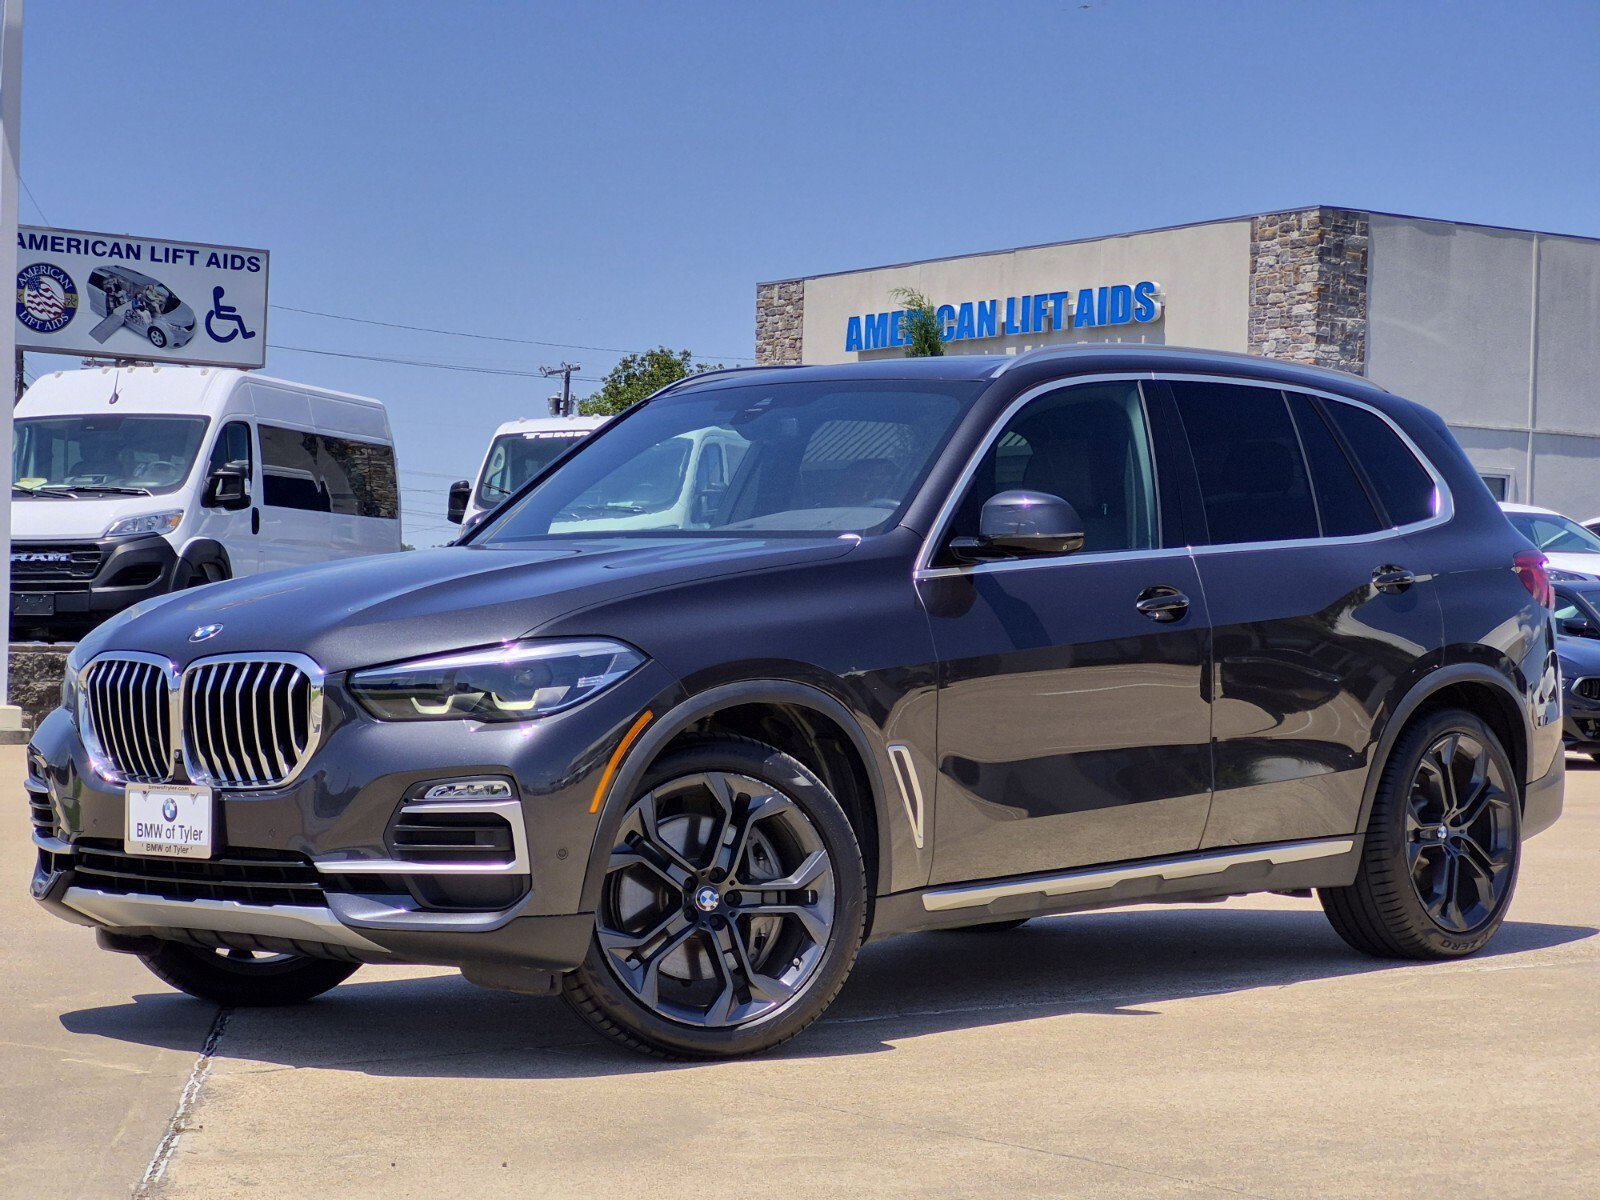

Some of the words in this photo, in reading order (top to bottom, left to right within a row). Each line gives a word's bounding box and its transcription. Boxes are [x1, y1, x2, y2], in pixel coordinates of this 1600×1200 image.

[16, 232, 142, 261] AMERICAN
[150, 245, 200, 267] LIFT
[205, 251, 261, 273] AIDS
[18, 265, 73, 290] AMERICAN
[20, 311, 44, 330] LIFT
[44, 313, 69, 331] AIDS
[845, 299, 999, 352] AMERCAN
[1005, 291, 1069, 335] LIFT
[1074, 281, 1158, 329] AIDS
[136, 822, 164, 839] BMW
[165, 824, 177, 840] of
[178, 824, 203, 844] Tyler
[146, 843, 164, 853] BMW
[165, 844, 172, 853] of
[173, 844, 190, 855] Tyler
